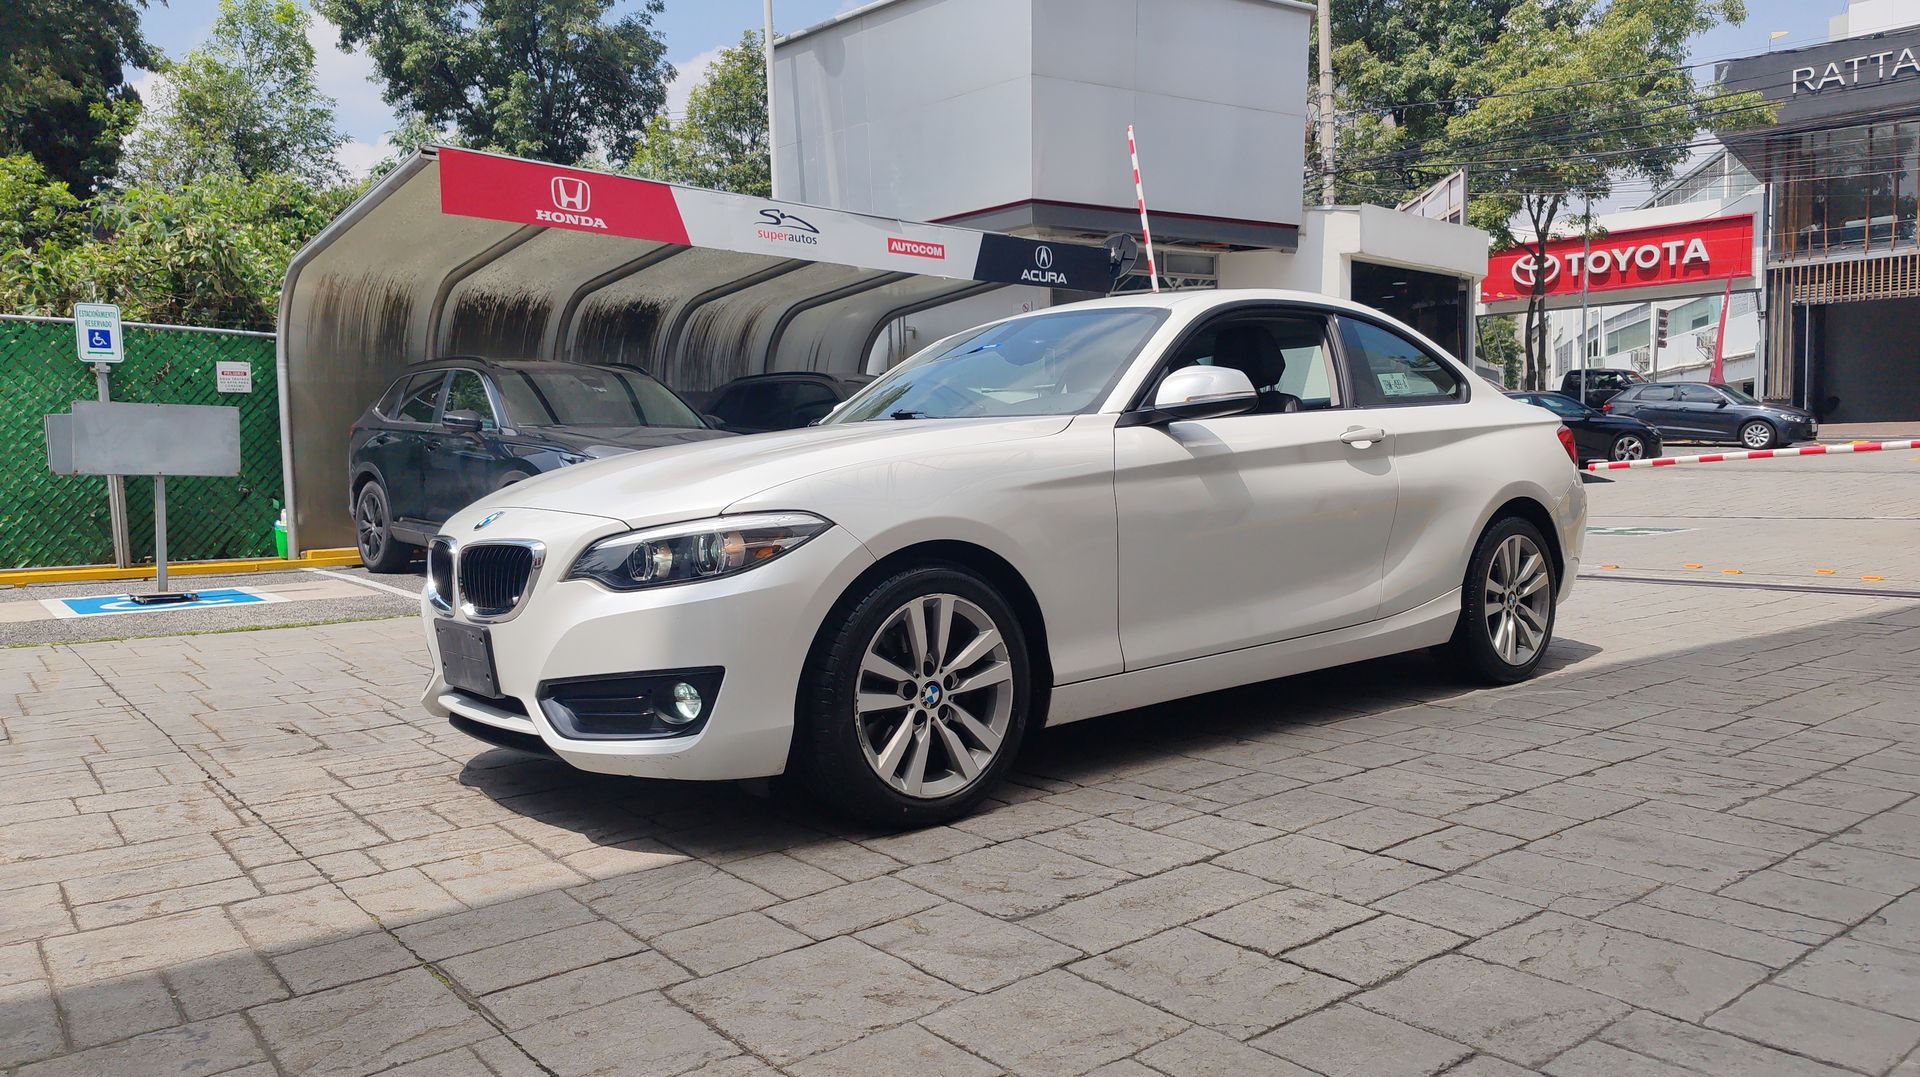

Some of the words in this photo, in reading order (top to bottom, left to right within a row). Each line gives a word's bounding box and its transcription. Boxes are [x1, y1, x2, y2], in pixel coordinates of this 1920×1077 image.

[1792, 48, 1920, 94] RATTA
[535, 209, 608, 229] HONDA
[757, 228, 818, 245] superautos
[890, 241, 943, 257] AUTOCOM
[1565, 238, 1710, 276] TOYOTA
[1020, 269, 1067, 284] ACURA
[85, 319, 112, 328] RESERVADO
